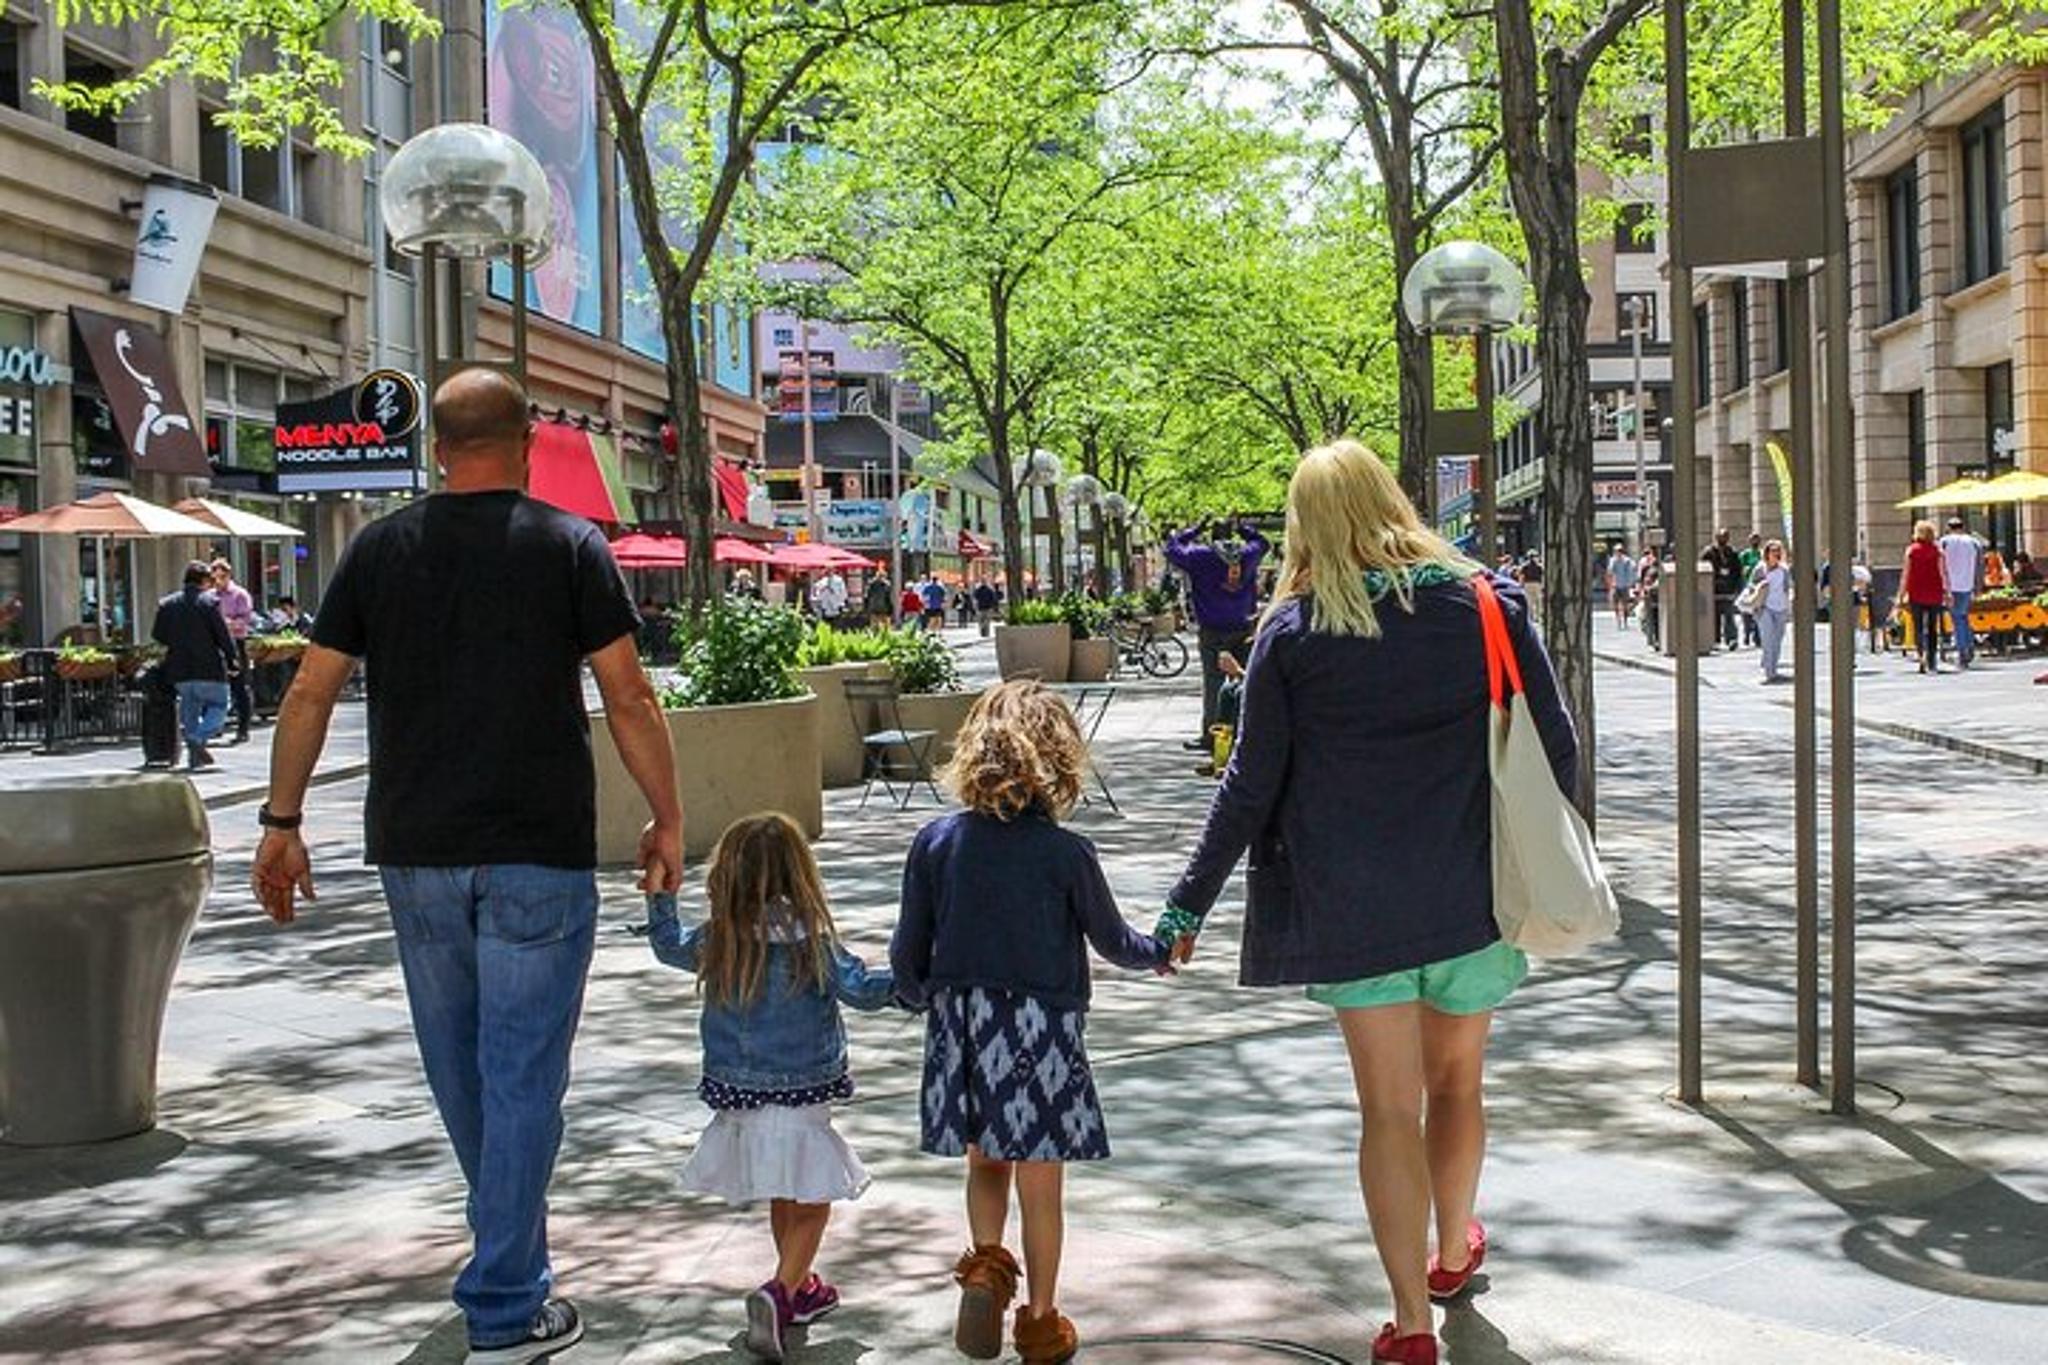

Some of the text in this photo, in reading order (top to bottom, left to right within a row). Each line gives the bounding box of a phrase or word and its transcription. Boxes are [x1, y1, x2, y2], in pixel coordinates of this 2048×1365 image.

[276, 422, 385, 447] MENYA
[278, 446, 408, 462] NOODLE BAR
